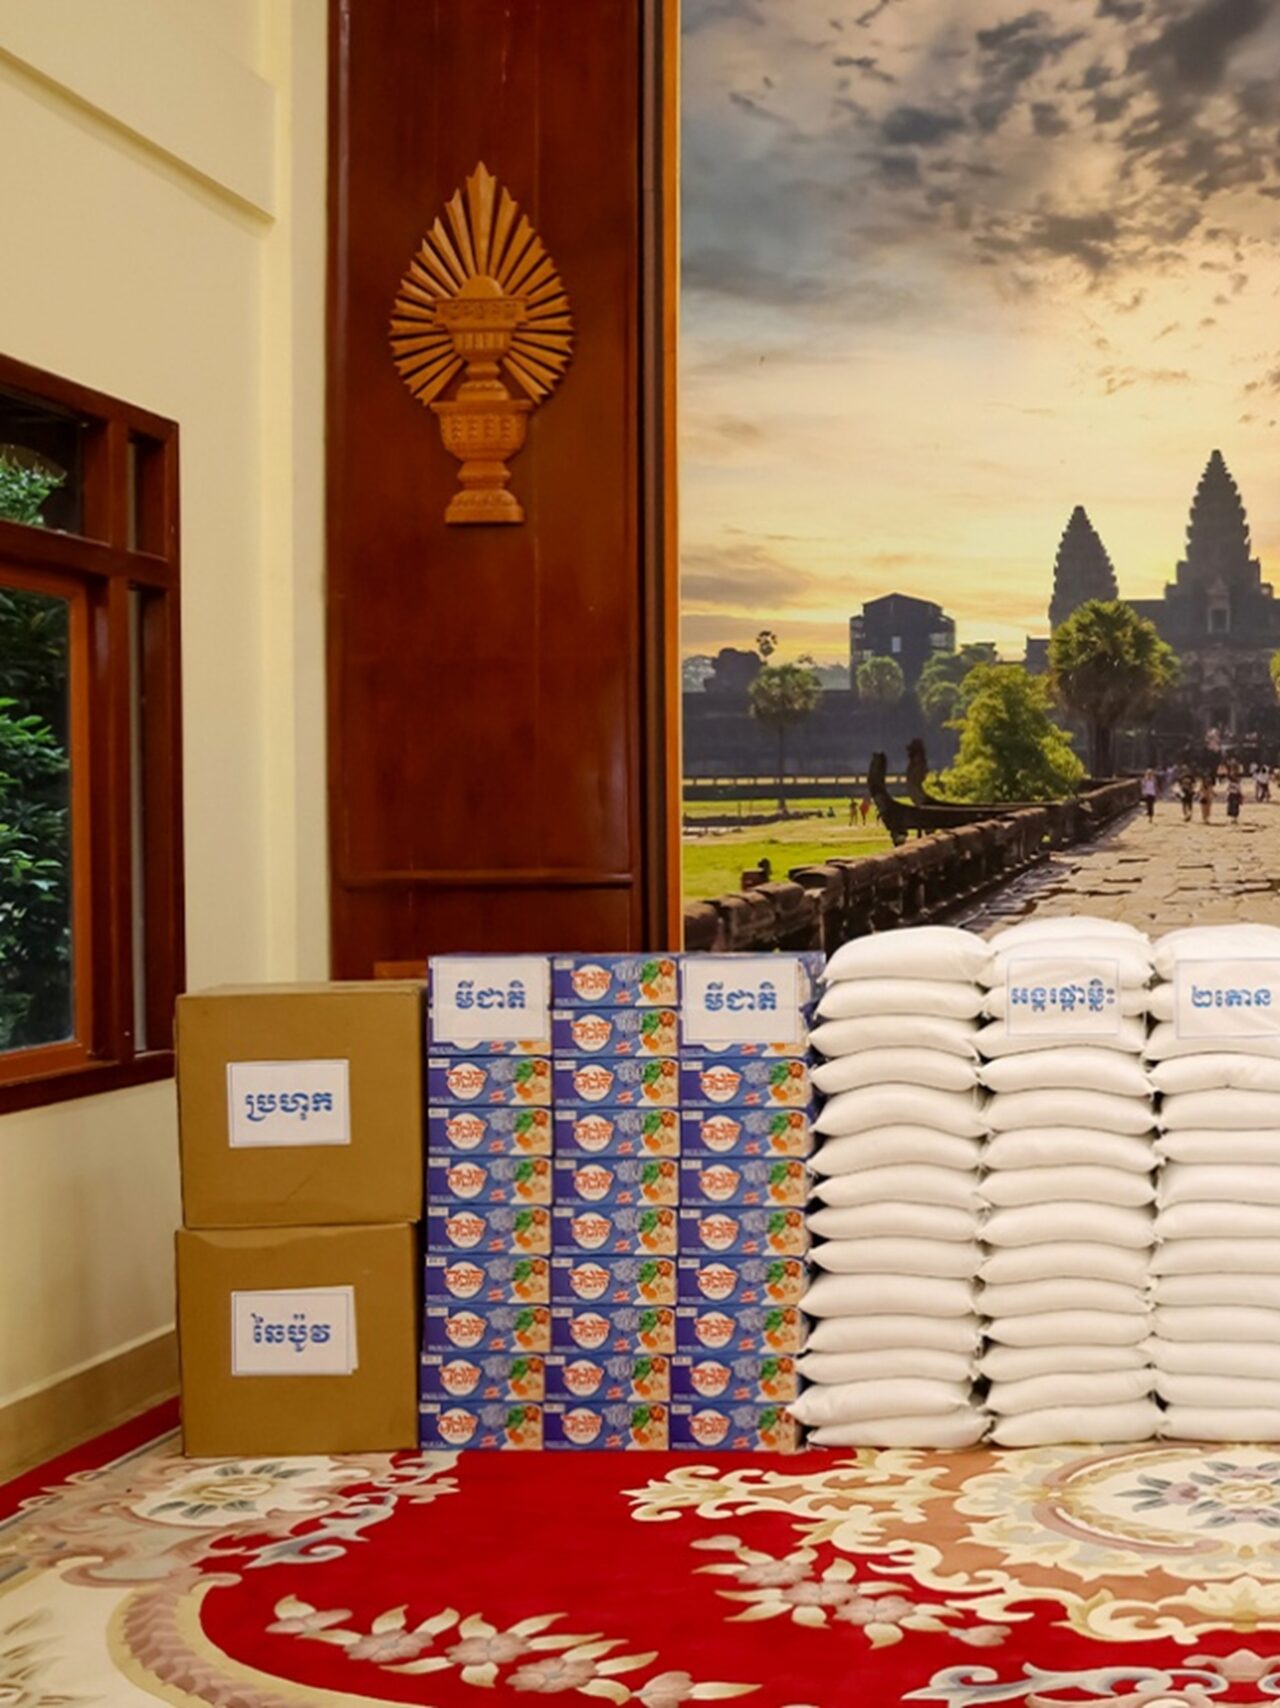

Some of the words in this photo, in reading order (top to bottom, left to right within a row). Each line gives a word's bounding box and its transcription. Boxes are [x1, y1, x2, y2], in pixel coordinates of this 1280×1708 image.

[455, 980, 526, 1010] មីជាតិ
[704, 981, 777, 1012] មីជាតិ
[245, 1092, 333, 1122] ប្រហុក
